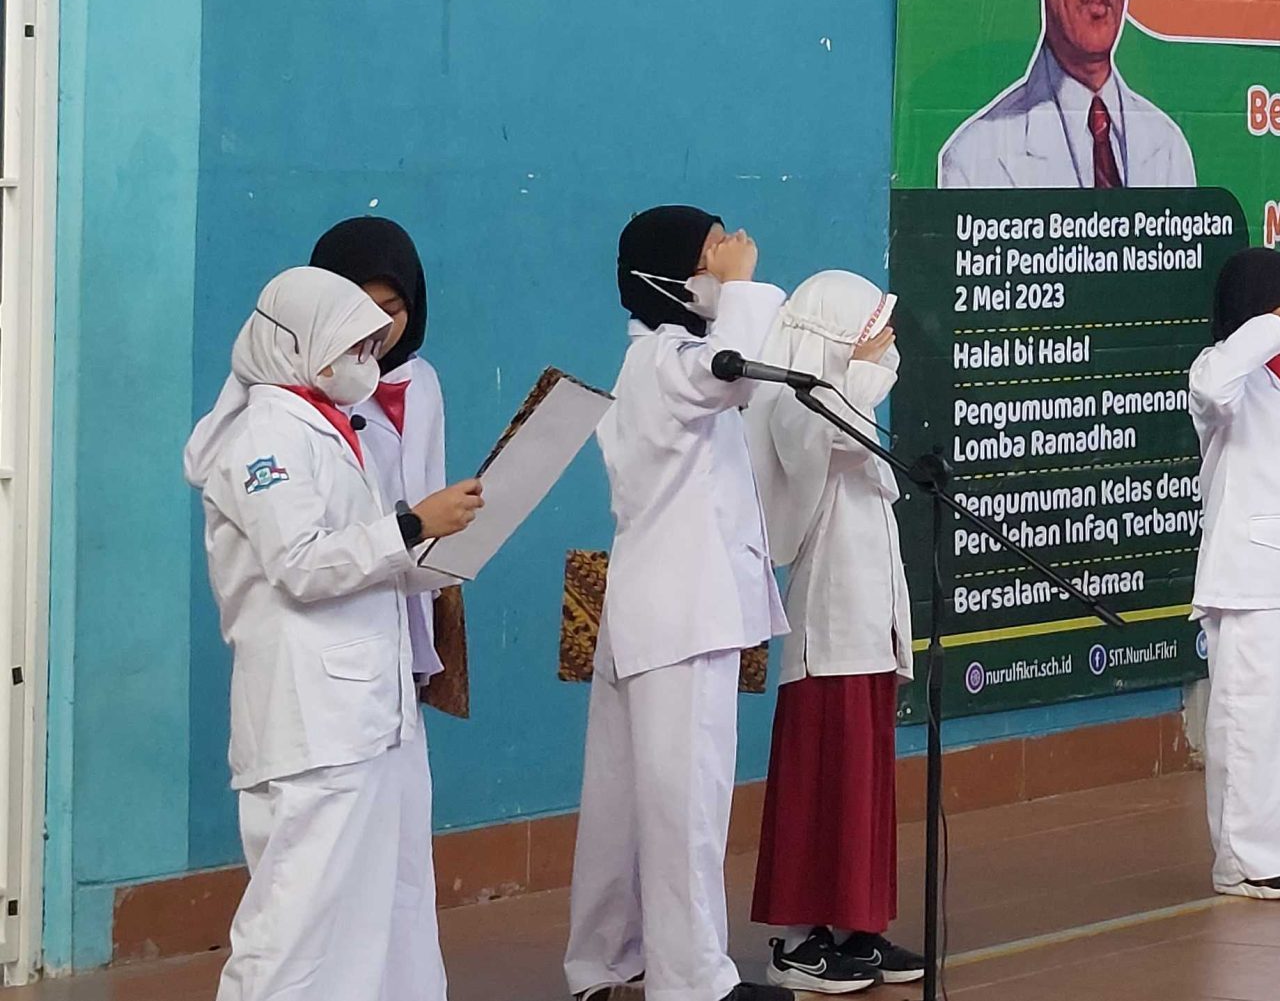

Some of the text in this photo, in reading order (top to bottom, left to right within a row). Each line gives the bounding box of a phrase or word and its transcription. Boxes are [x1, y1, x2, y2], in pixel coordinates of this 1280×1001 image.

[956, 208, 1233, 246] Upacara Bendera Peringatan
[956, 242, 1202, 277] Hari Pendidikan Nasional
[954, 281, 1065, 312] 2 Mei 2023
[954, 335, 1090, 370] Halal bi Halal
[954, 389, 1190, 429] Pengumuman Pemenan
[954, 423, 1136, 462] Lomba Ramadhan
[954, 485, 1096, 522] Pengumuman
[1101, 475, 1152, 506] Kelas
[1065, 514, 1119, 545] Infaq
[985, 654, 1072, 686] nurulfikri.sch.id
[1109, 640, 1177, 668] SIT.Nurul.Fikri
